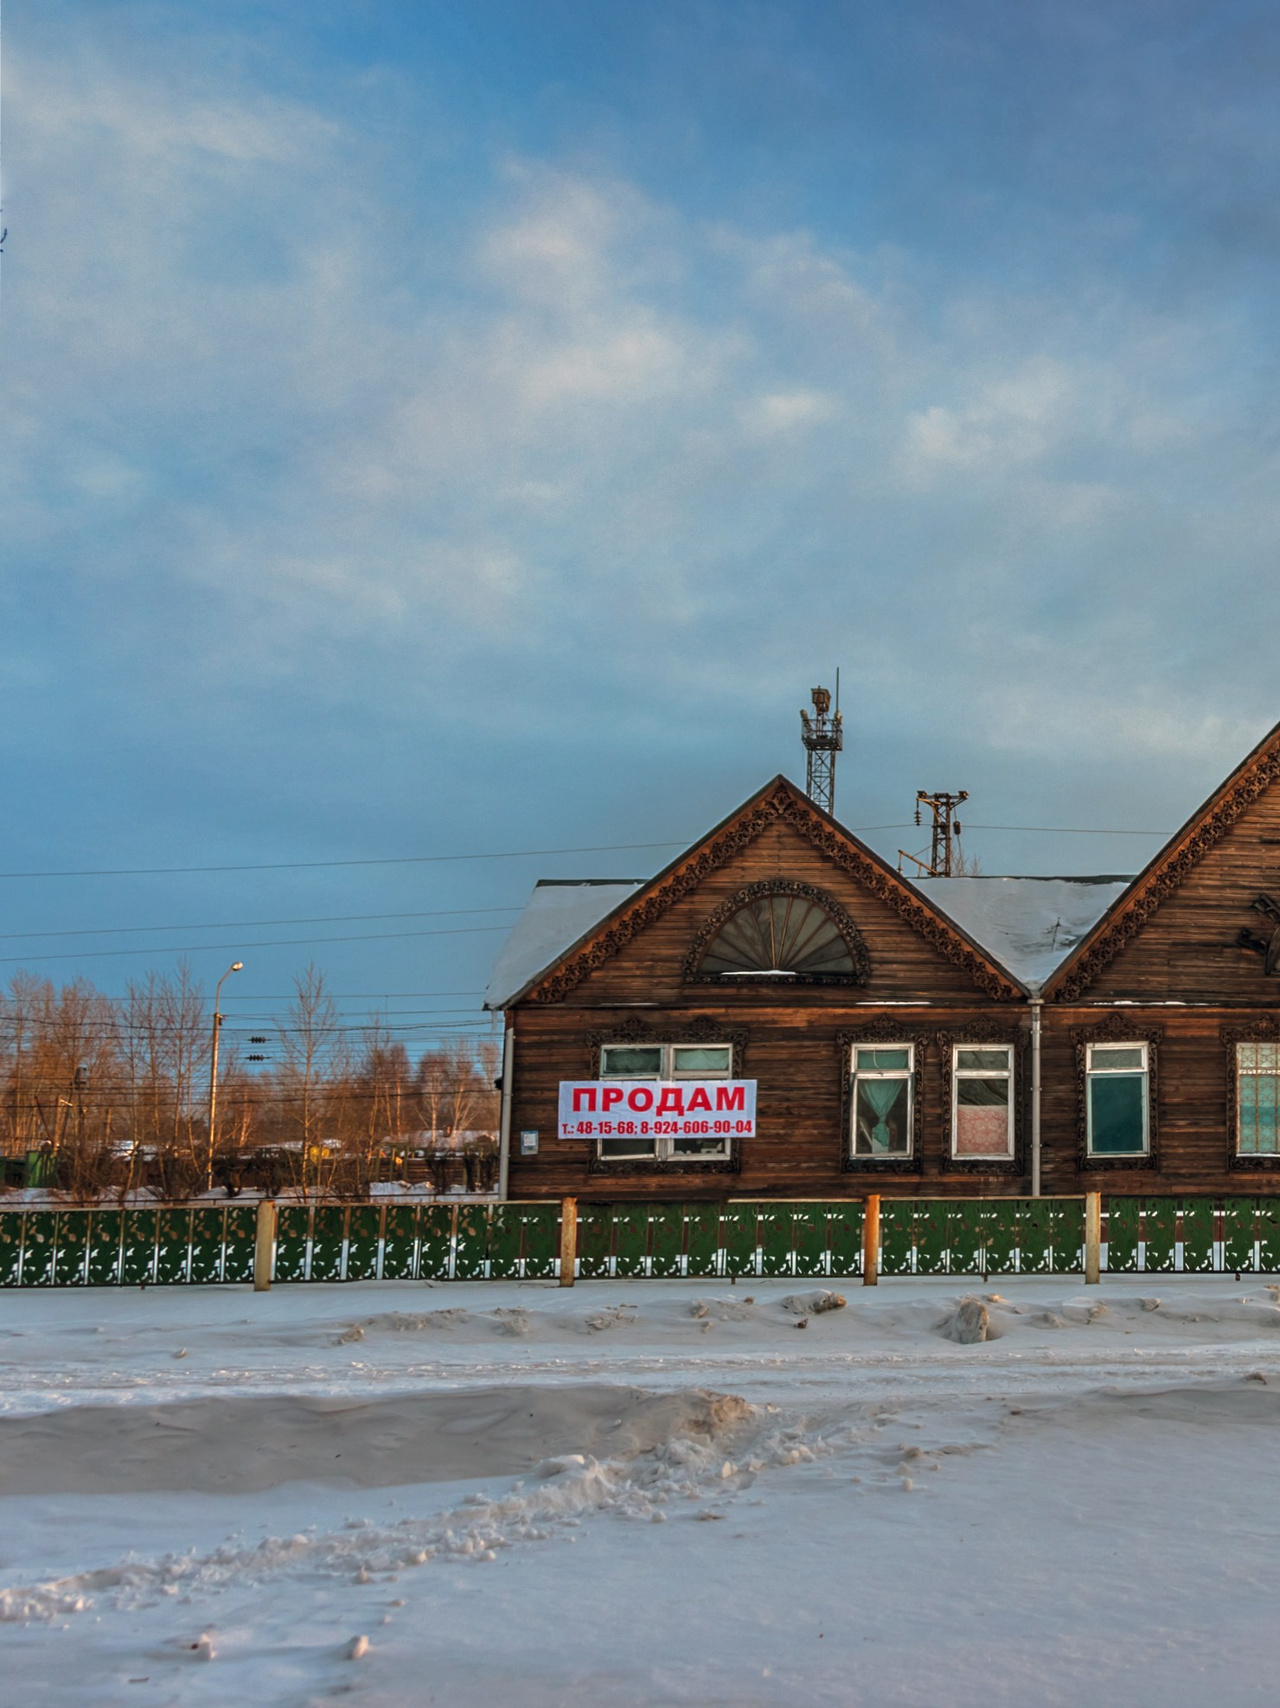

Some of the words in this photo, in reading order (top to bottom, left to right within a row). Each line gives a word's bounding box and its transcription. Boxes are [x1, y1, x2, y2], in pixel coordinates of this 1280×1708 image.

[572, 1087, 745, 1117] ПРОДАМ
[576, 1121, 638, 1135] 48-15-68;
[640, 1120, 752, 1134] 8-924-606-90-04
